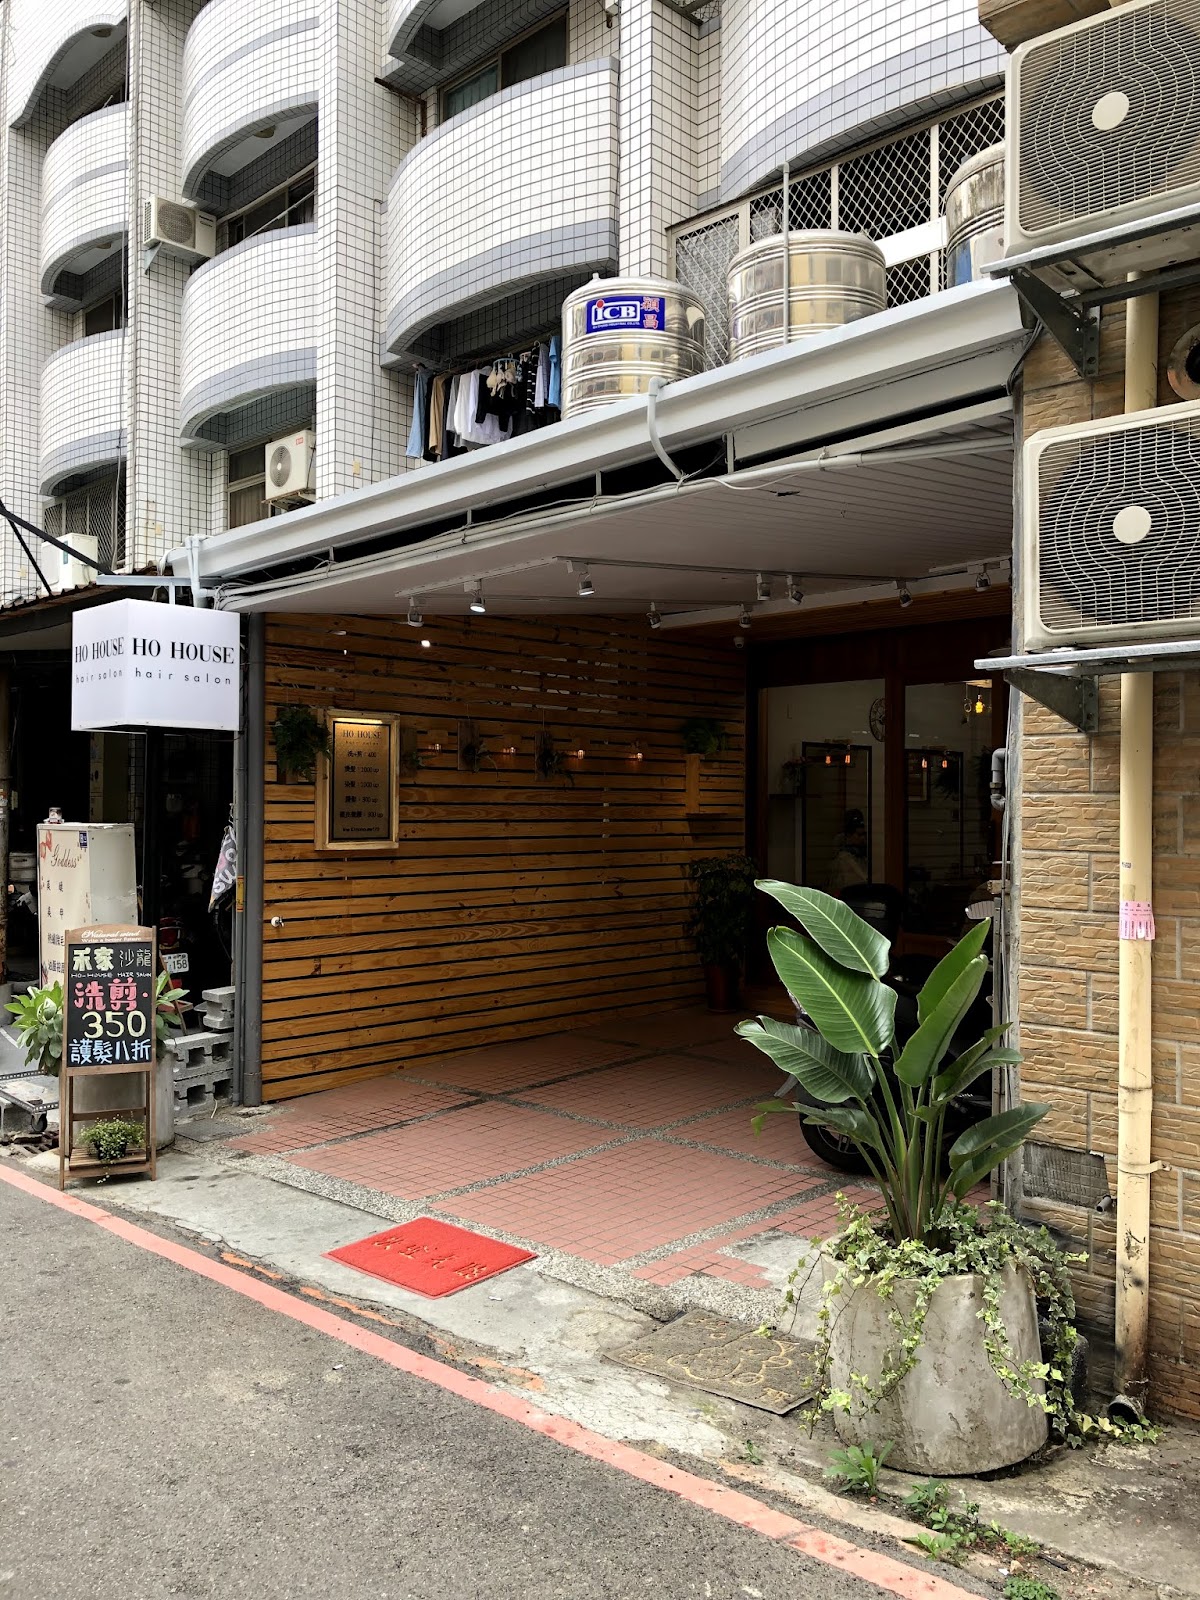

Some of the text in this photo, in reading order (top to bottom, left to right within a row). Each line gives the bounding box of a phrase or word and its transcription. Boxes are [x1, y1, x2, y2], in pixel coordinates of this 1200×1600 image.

[75, 636, 125, 663] HO HOUSE
[132, 637, 234, 664] HO HOUSE
[75, 669, 122, 683] hair salon
[135, 667, 231, 685] hair salon
[342, 730, 382, 739] HO HOUSE
[50, 844, 77, 869] Goddess
[81, 929, 141, 938] Natural wind
[72, 946, 115, 972] 禾家
[119, 948, 152, 968] 沙龍
[81, 1010, 147, 1039] 350
